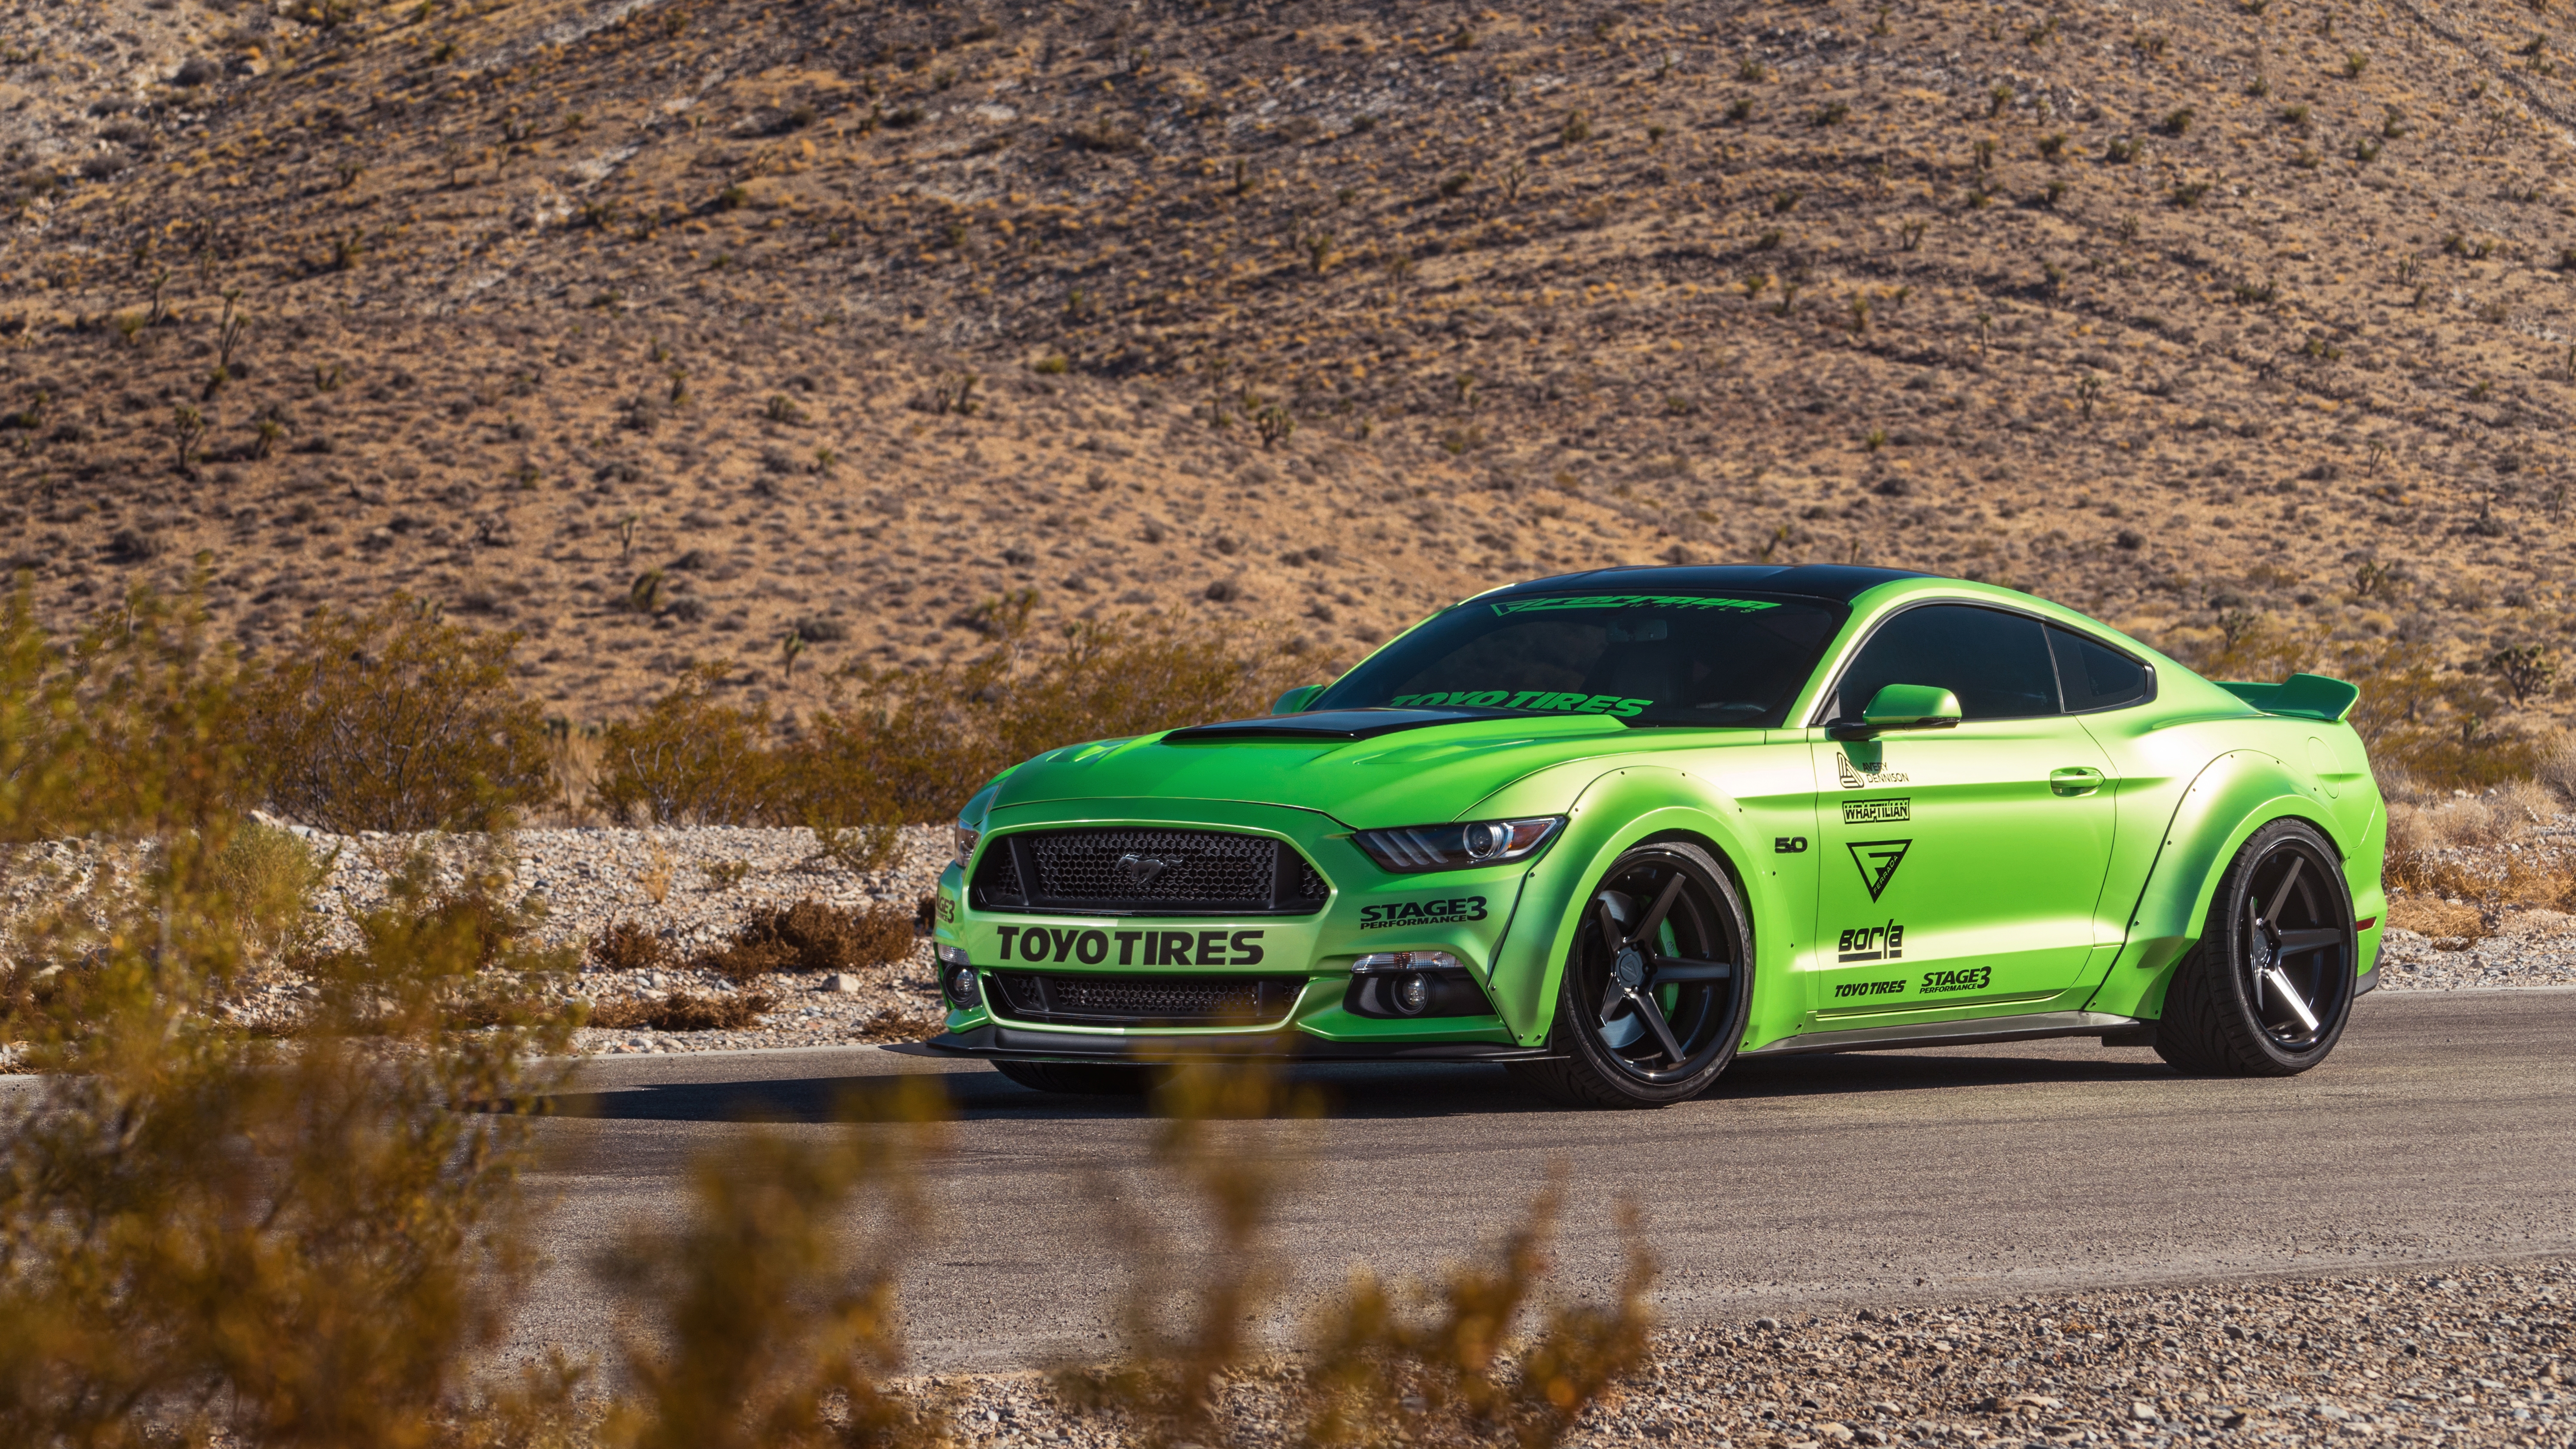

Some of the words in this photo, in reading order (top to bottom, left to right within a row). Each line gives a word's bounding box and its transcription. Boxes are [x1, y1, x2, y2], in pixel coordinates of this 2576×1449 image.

[1630, 602, 1756, 614] WHEELS
[1391, 690, 1509, 707] TOYO
[1504, 691, 1654, 717] TIRES
[1862, 762, 1888, 772] AVERY
[1866, 773, 1909, 783] DENNISON
[1844, 799, 1909, 821] WRAPTILIAN
[1873, 855, 1898, 894] FERRADA
[1360, 915, 1467, 930] PERFORMANCE
[996, 926, 1109, 965] TOYO
[1114, 930, 1265, 966] TIRES
[1835, 982, 1869, 998] TOYO
[1869, 980, 1907, 995] TIRES
[1919, 983, 1977, 994] PERFORMANCE
